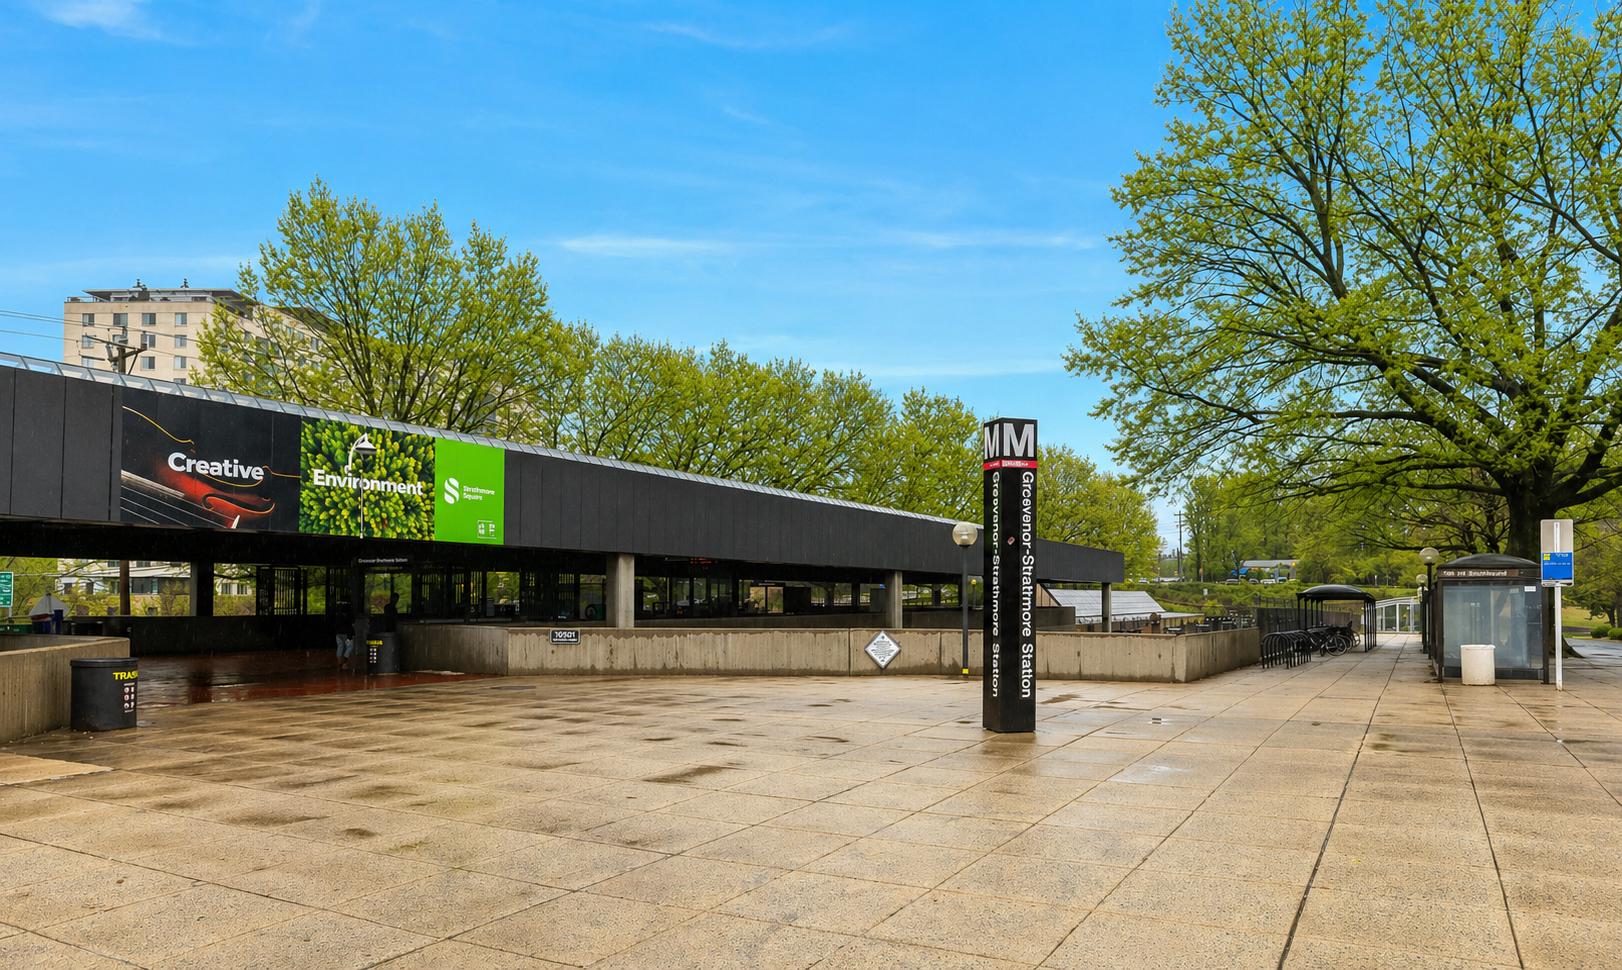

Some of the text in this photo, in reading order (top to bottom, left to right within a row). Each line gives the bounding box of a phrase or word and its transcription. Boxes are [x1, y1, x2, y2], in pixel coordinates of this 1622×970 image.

[984, 423, 1000, 460] M
[1003, 422, 1035, 458] M
[167, 452, 264, 481] Creative
[312, 468, 424, 496] Environment
[112, 671, 138, 680] TRAS
[992, 643, 1000, 698] Station
[1021, 643, 1034, 699] Station
